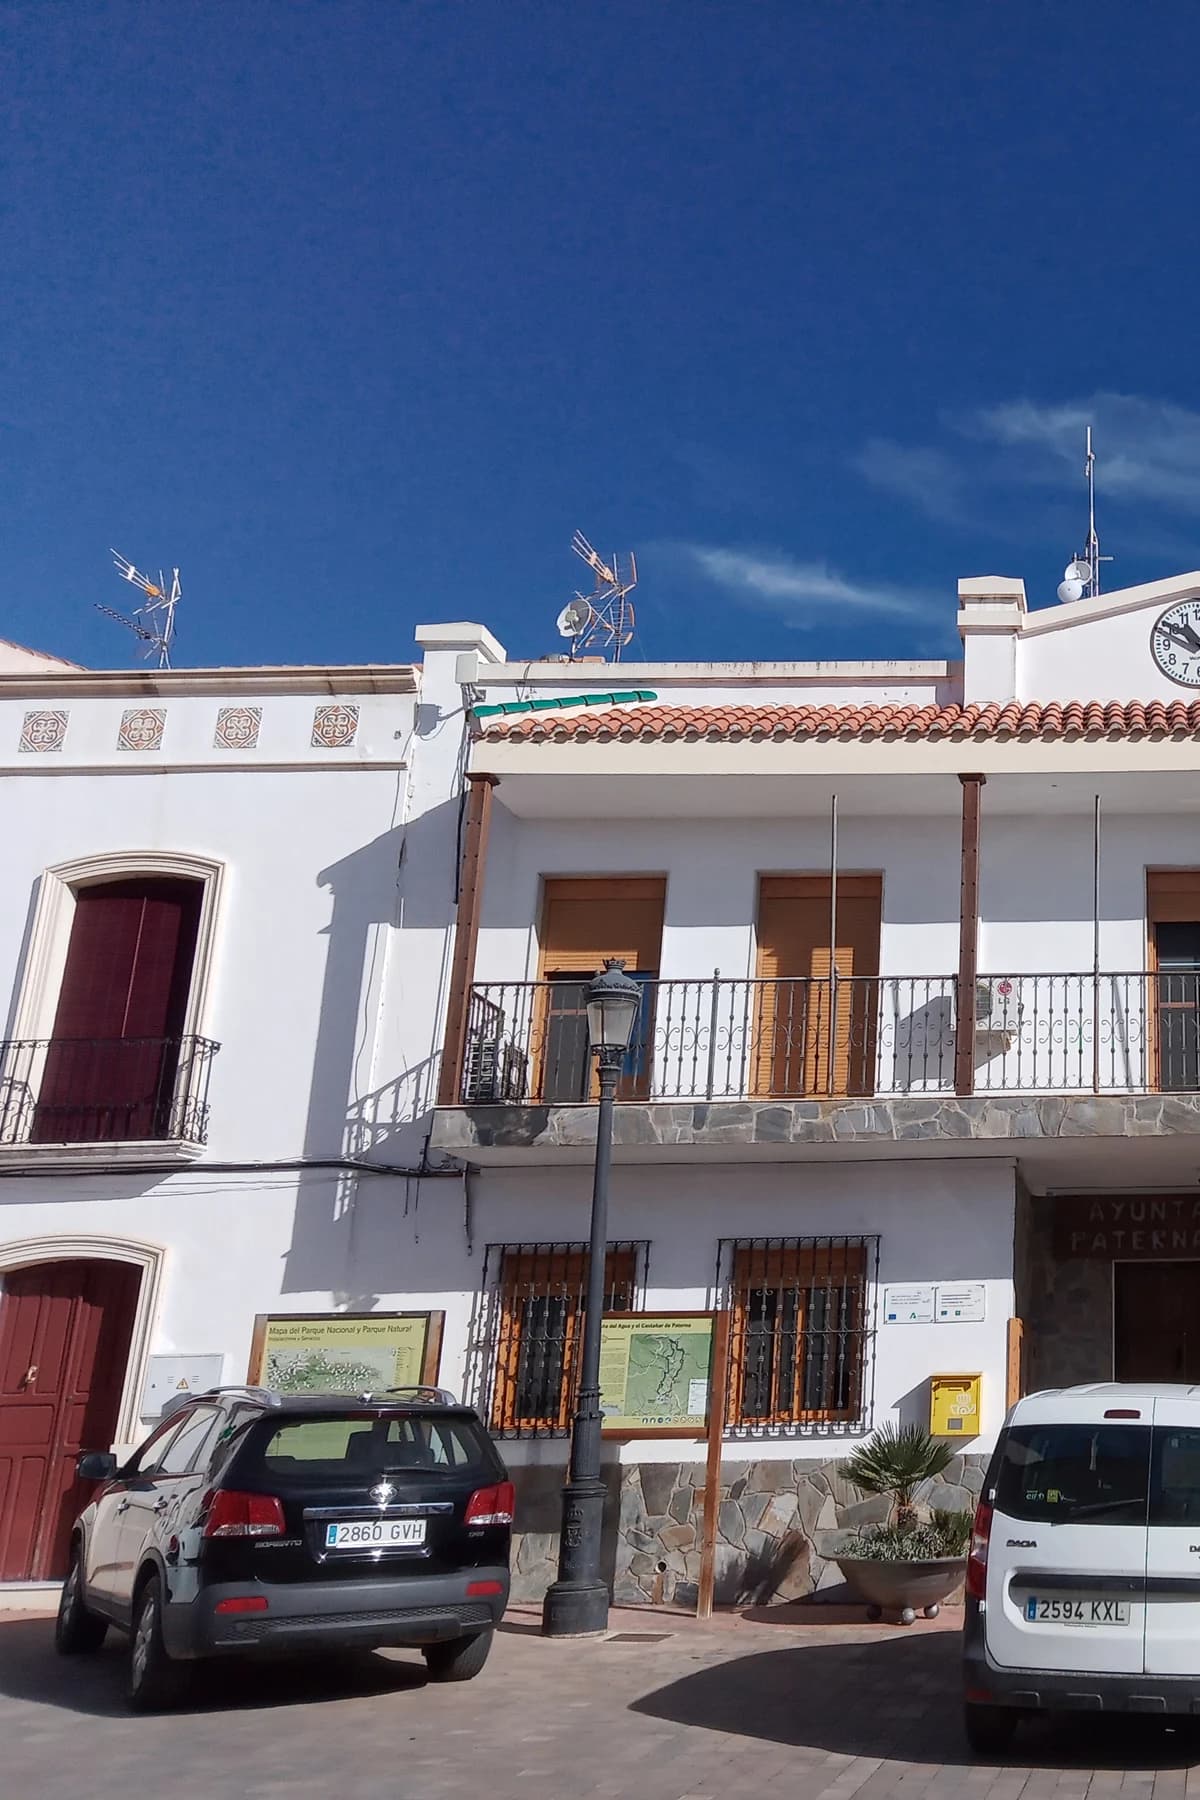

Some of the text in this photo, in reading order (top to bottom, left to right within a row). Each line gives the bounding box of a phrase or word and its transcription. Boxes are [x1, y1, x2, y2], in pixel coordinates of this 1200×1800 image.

[1179, 613, 1189, 625] 11
[1162, 639, 1171, 651] 9
[1168, 653, 1177, 666] 8
[1182, 662, 1190, 675] 7
[269, 1327, 288, 1335] Mapa
[289, 1327, 300, 1335] del
[301, 1326, 325, 1336] Parque
[326, 1326, 356, 1335] Nacional
[362, 1325, 386, 1335] Parque
[387, 1325, 412, 1333] Natural
[340, 1524, 422, 1543] 2860 GVH
[1040, 1600, 1125, 1621] 2594 KXL
